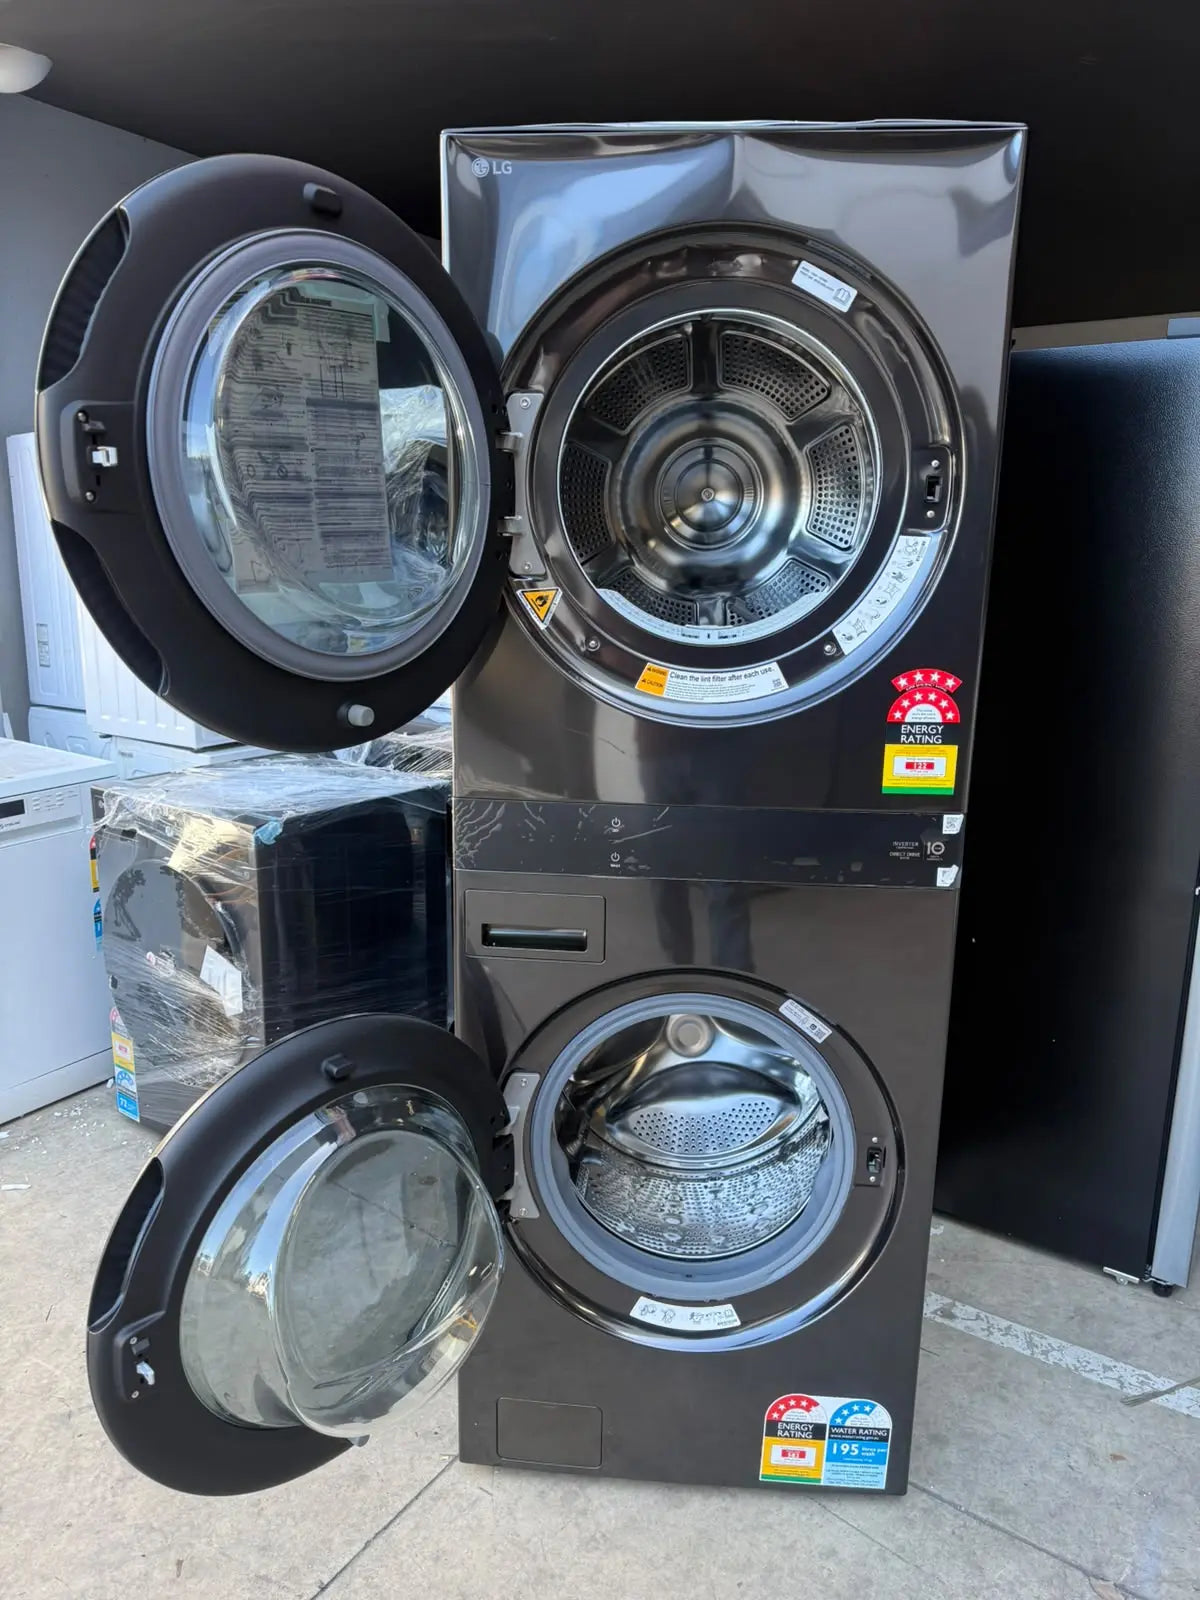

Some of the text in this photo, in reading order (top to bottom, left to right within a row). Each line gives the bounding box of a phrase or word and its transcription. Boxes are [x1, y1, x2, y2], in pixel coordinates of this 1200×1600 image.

[492, 161, 512, 175] LG
[670, 671, 688, 681] Clean
[712, 675, 727, 683] filter
[728, 673, 743, 682] after
[743, 671, 760, 680] each
[761, 666, 775, 675] use.
[901, 724, 945, 734] ENERGY
[900, 735, 943, 744] RATING
[777, 1422, 814, 1431] ENERGY
[777, 1430, 812, 1438] RATING
[831, 1427, 887, 1436] WATER RATING
